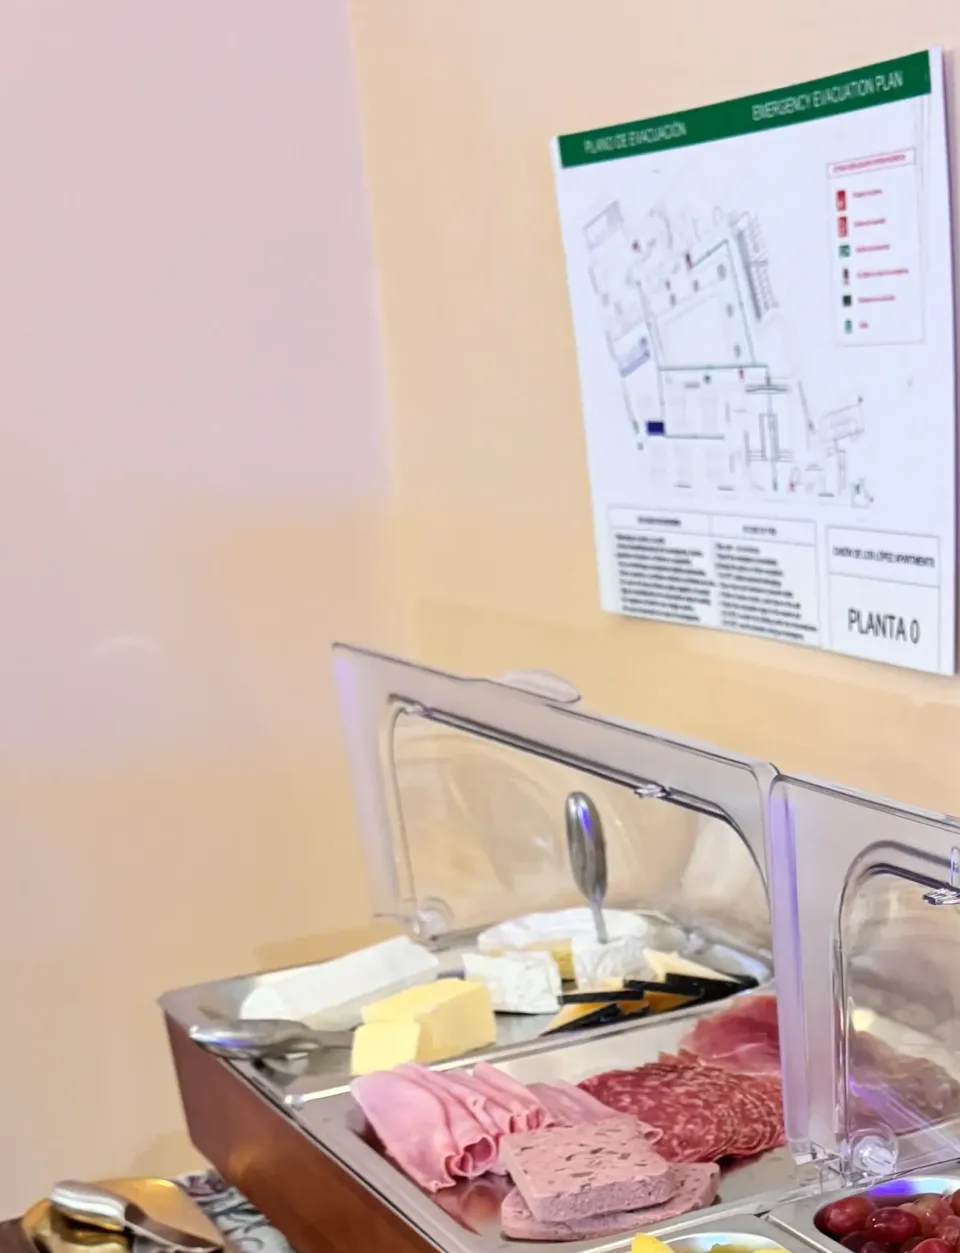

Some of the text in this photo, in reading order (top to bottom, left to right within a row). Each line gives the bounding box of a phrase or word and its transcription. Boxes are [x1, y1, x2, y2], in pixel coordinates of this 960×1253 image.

[752, 70, 904, 121] EMERGENCY EVACUATION PLAN
[615, 132, 628, 150] DE
[847, 607, 921, 645] PLANTA 0
